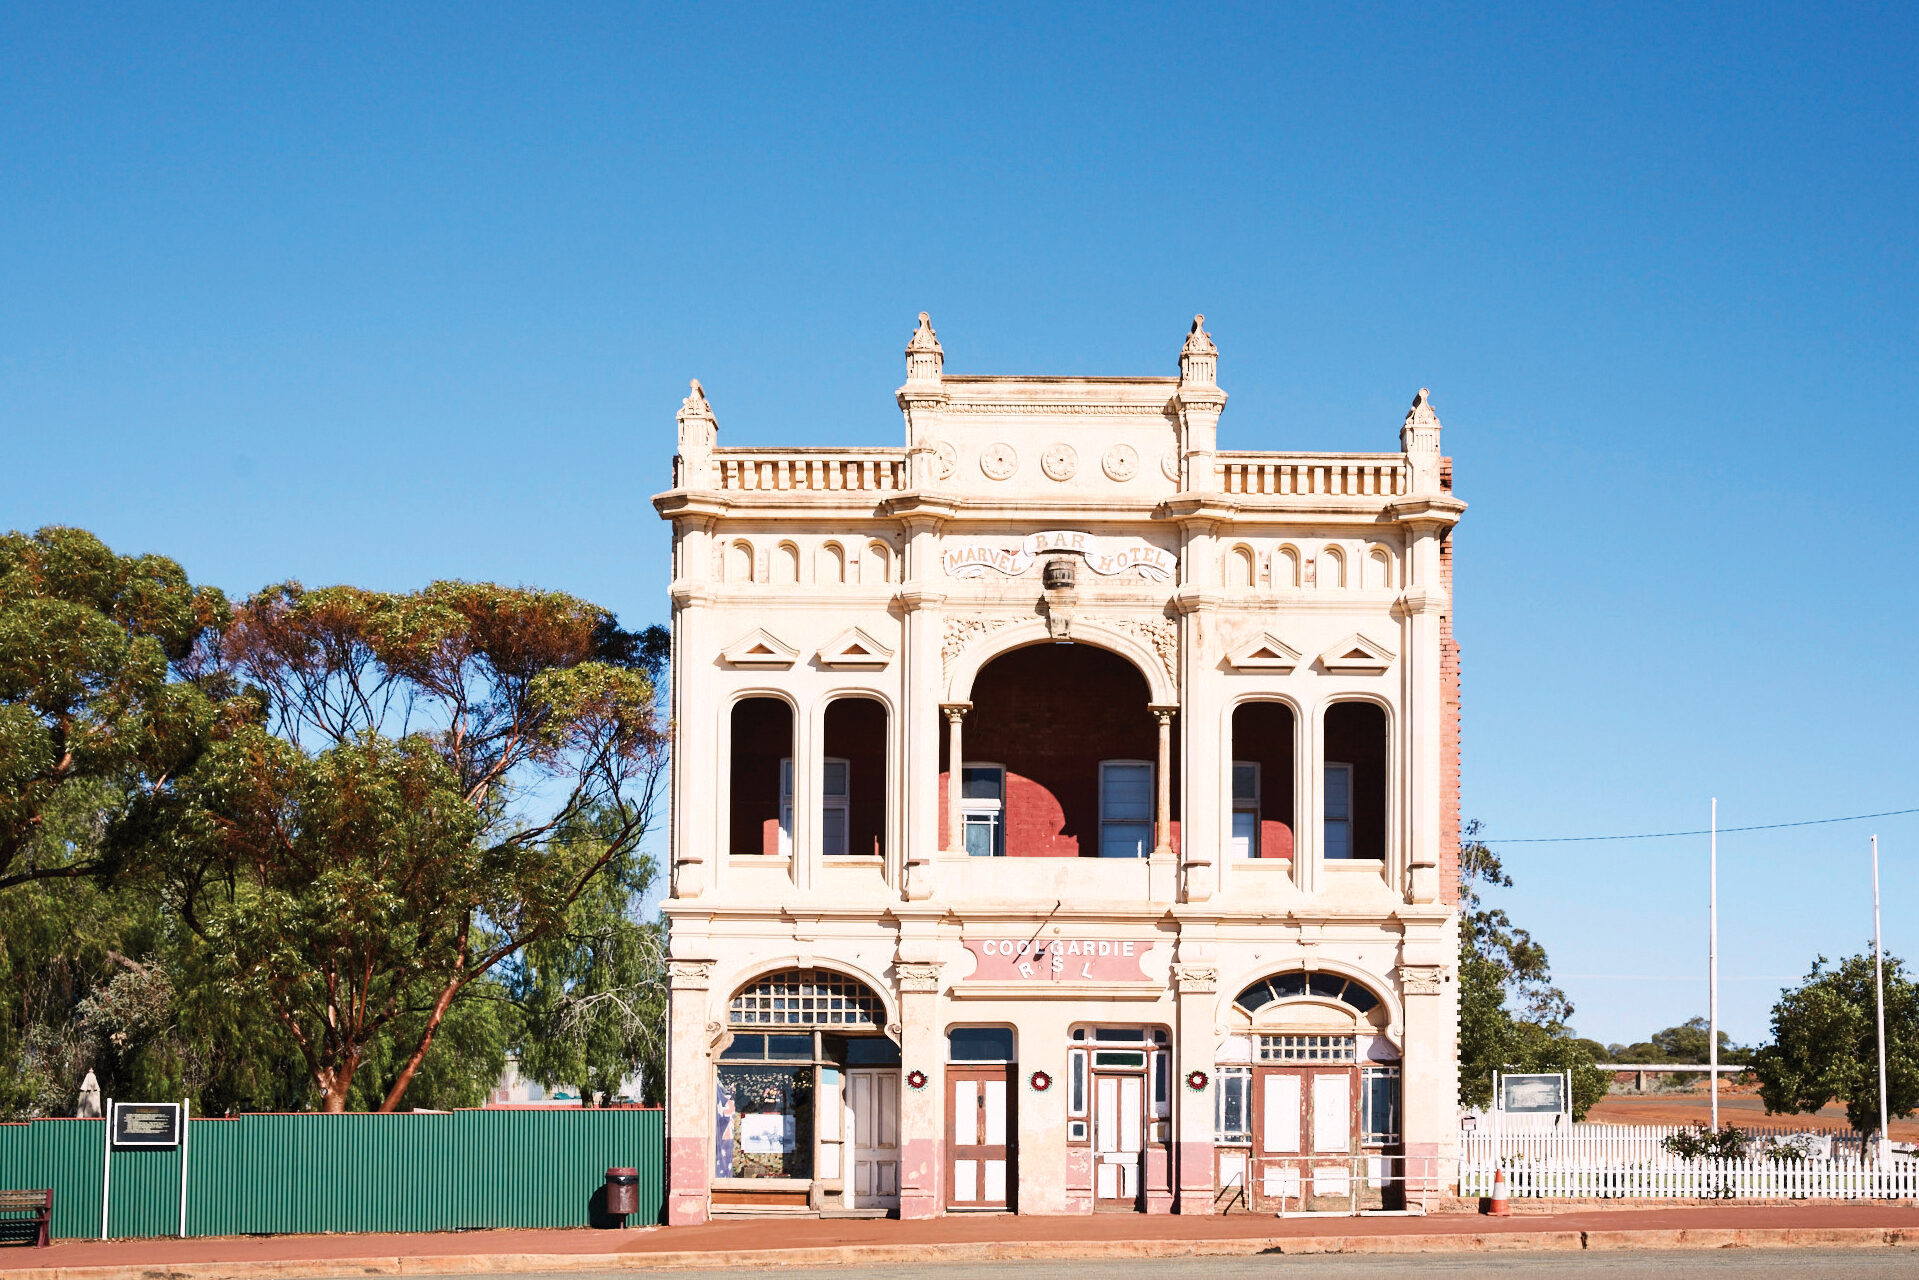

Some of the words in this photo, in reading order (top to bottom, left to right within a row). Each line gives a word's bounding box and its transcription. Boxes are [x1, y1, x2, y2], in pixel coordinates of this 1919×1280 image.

[948, 548, 1022, 573] MARVEL
[1036, 532, 1085, 549] BAR
[1099, 547, 1166, 572] HOTEL
